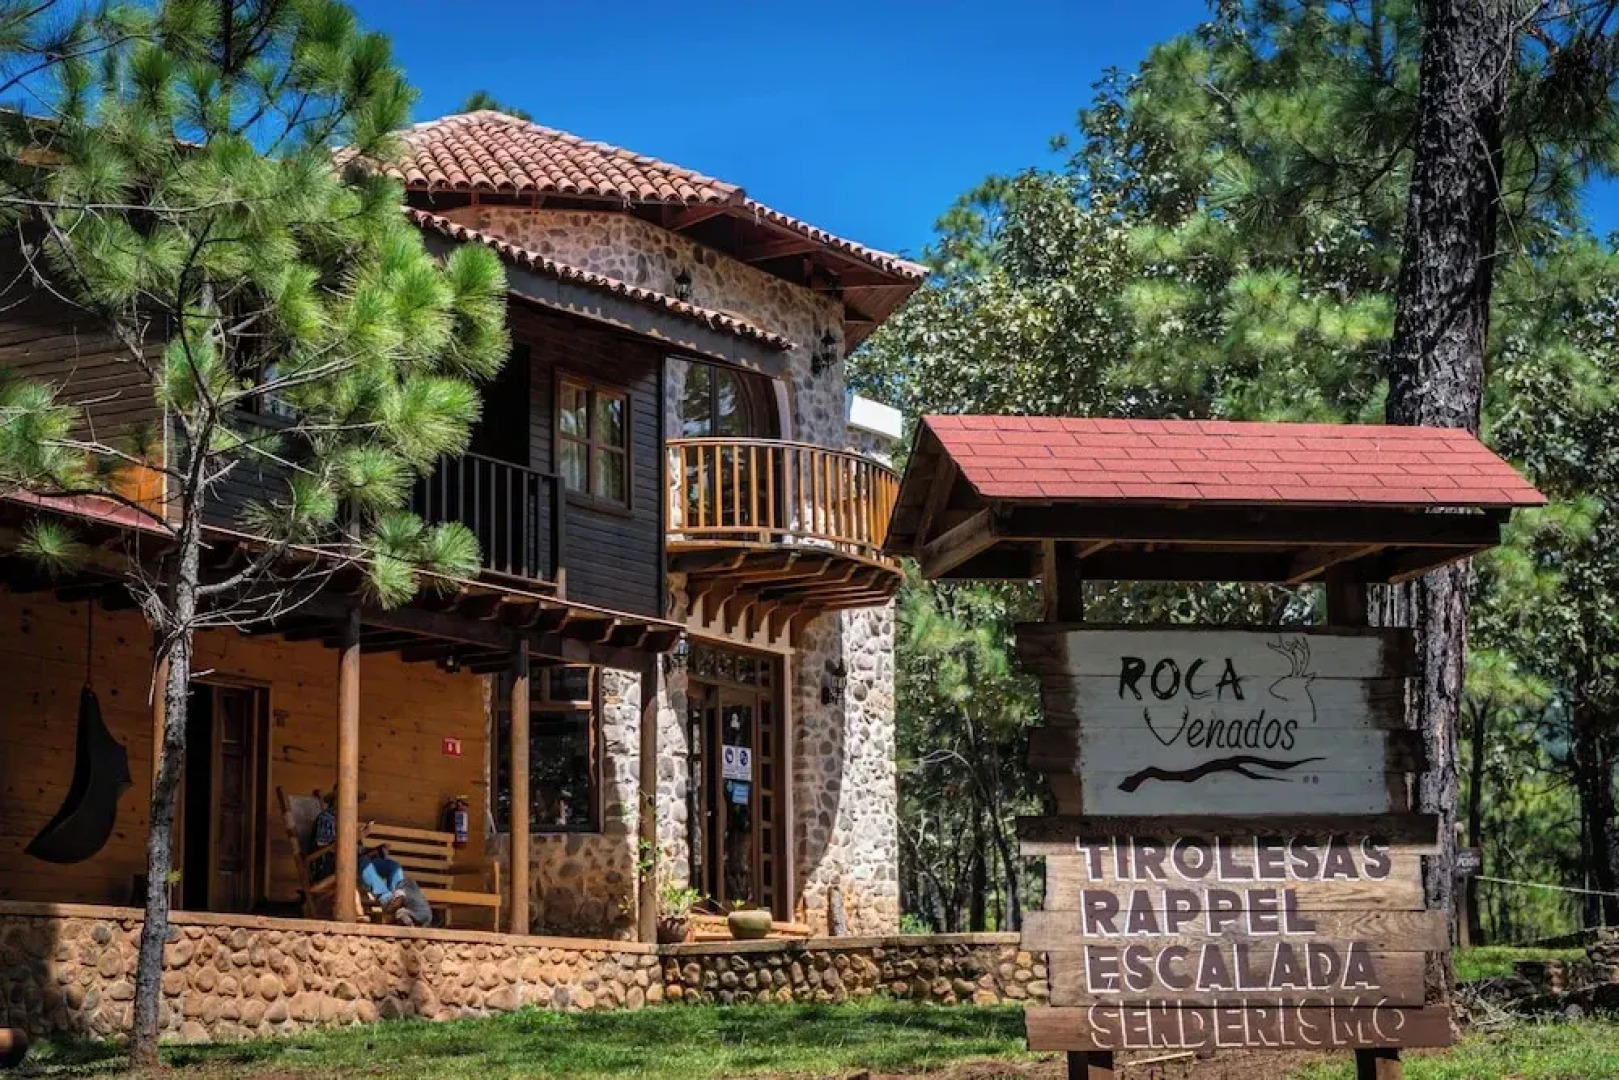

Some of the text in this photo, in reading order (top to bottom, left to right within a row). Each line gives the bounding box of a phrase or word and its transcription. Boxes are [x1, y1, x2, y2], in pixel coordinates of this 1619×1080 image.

[1118, 656, 1244, 701] ROCA
[1144, 706, 1299, 750] Venados
[1075, 835, 1392, 882] TIROLESAS
[1081, 889, 1317, 937] RAPPEL
[1084, 942, 1380, 993] ESCALADA
[1087, 999, 1405, 1049] SENDERISMO
